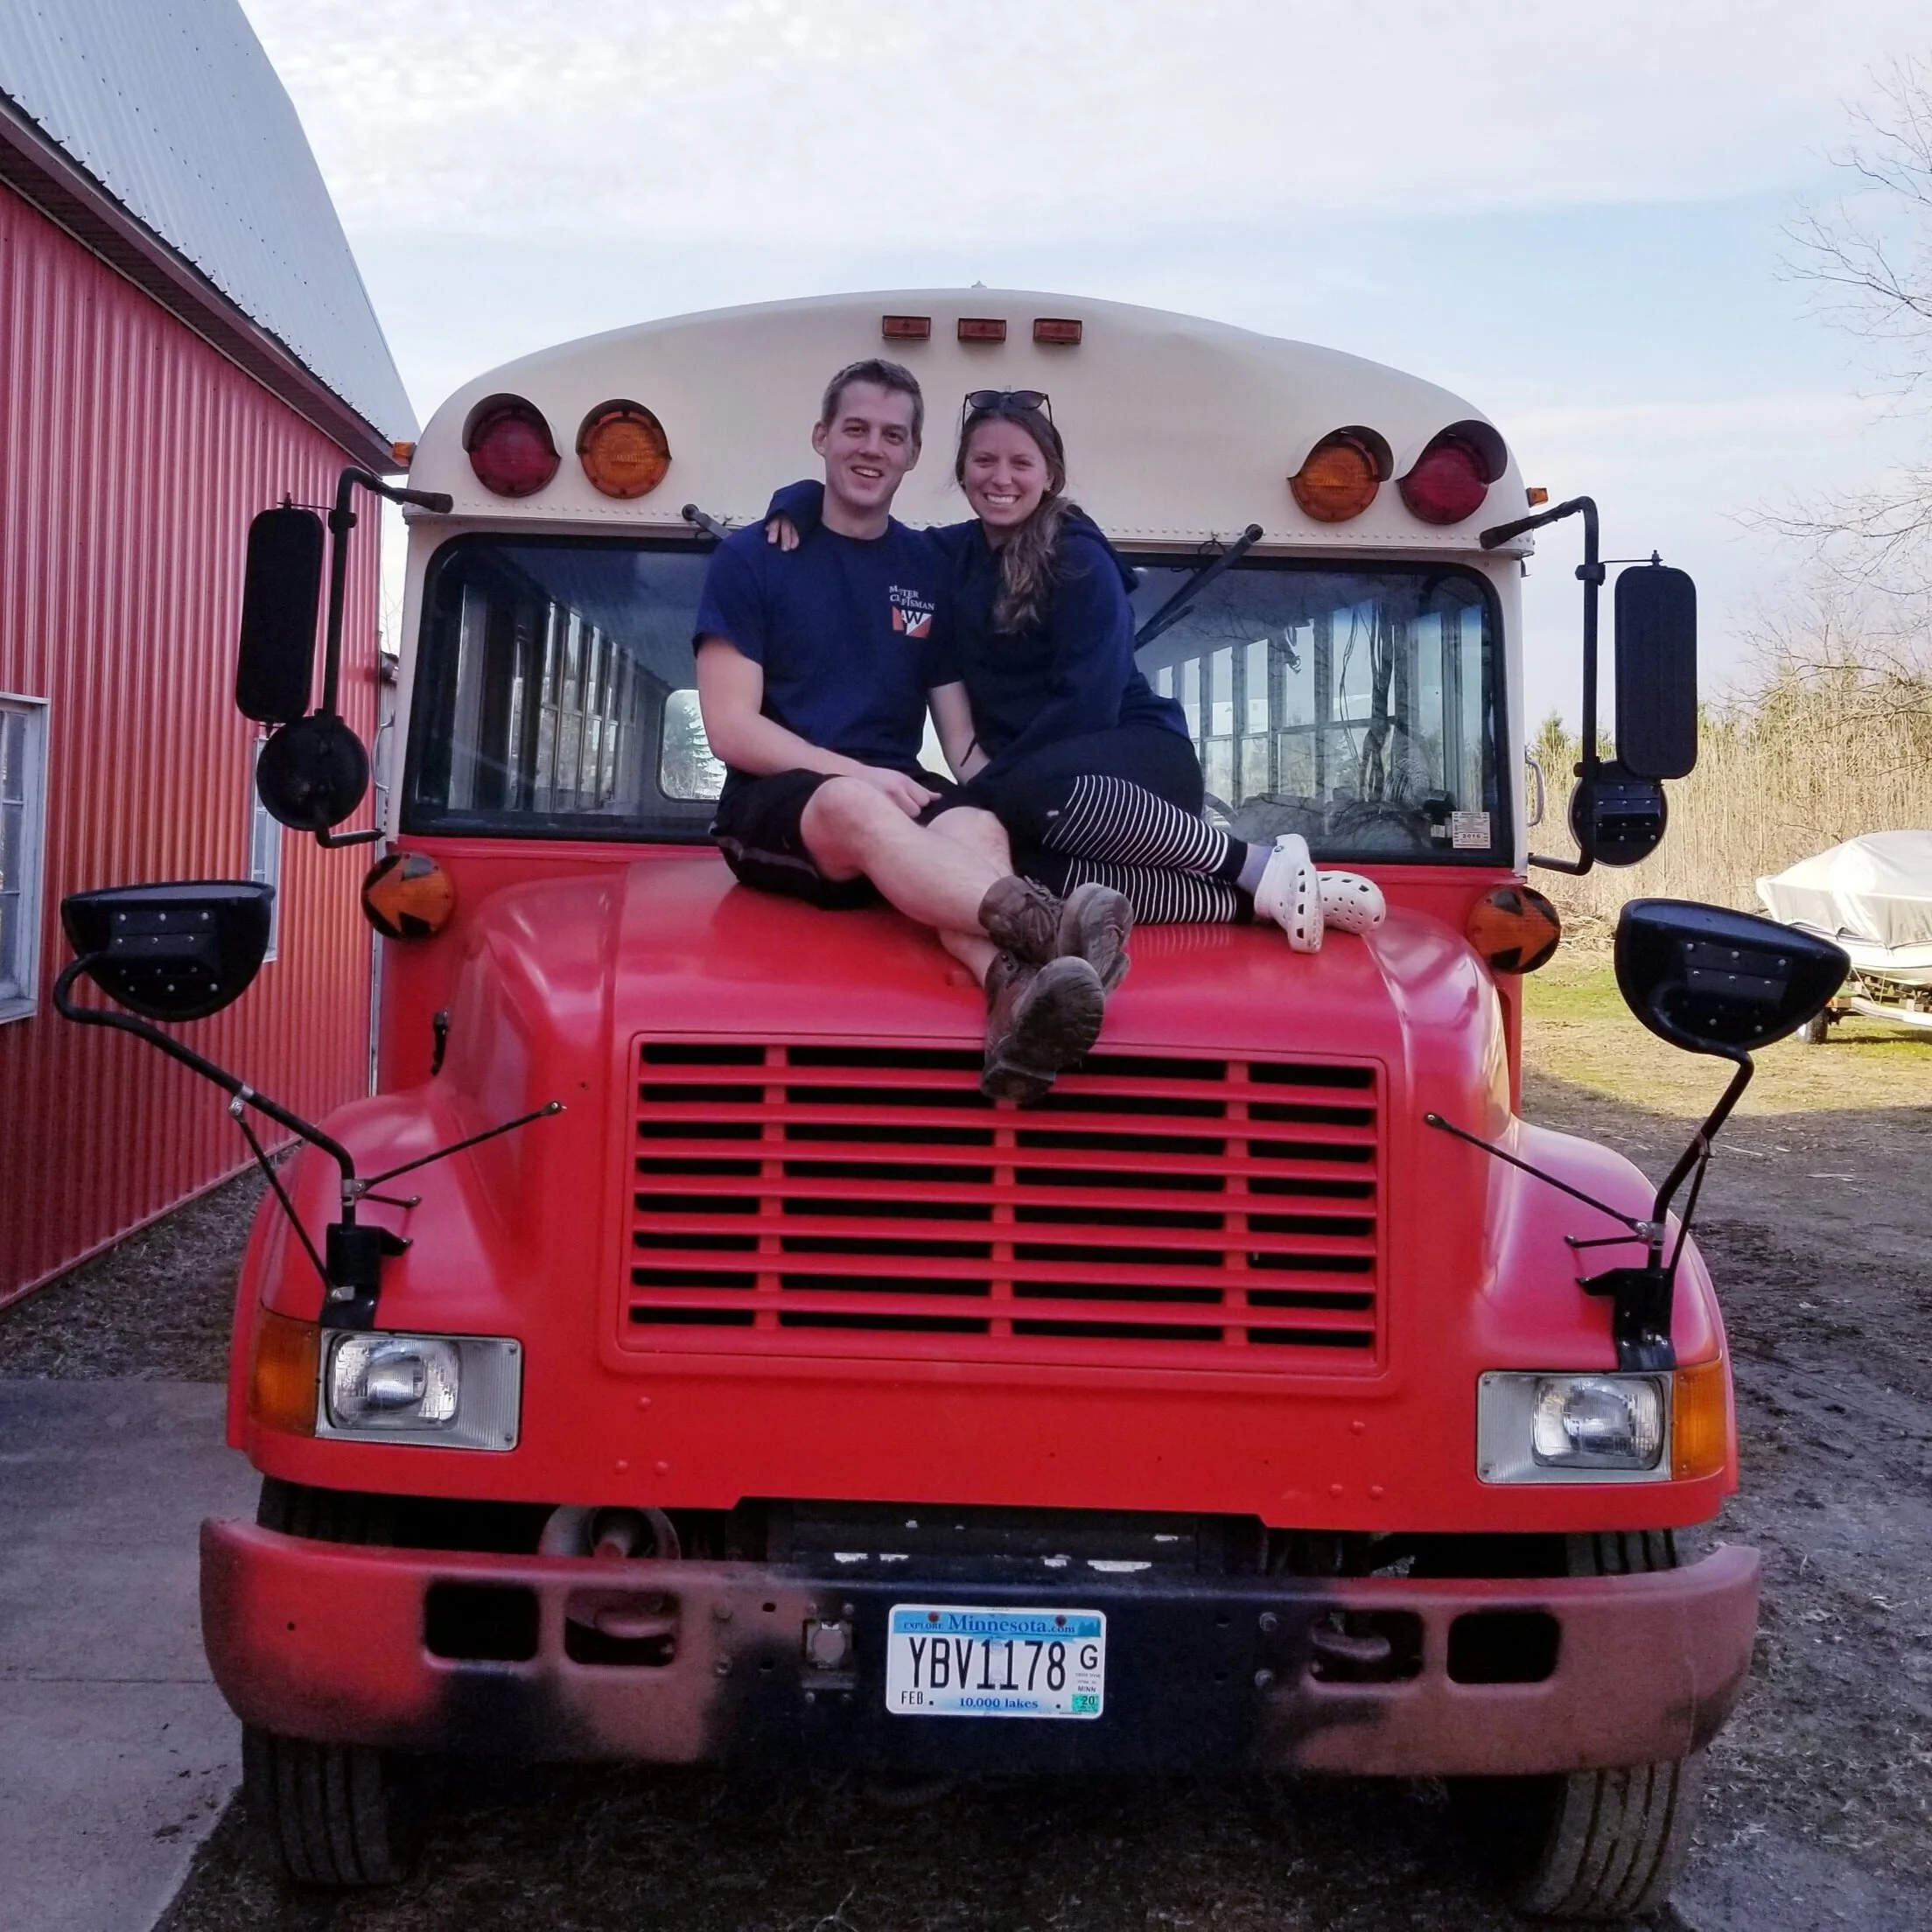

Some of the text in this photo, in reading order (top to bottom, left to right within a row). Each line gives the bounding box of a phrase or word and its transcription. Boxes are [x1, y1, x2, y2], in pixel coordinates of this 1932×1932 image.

[889, 585, 919, 598] MTER
[908, 1636, 1098, 1691] YBV1178 G
[901, 1690, 924, 1705] FEB
[959, 1697, 1039, 1709] 10,000 lakes
[1082, 1695, 1096, 1705] 20
